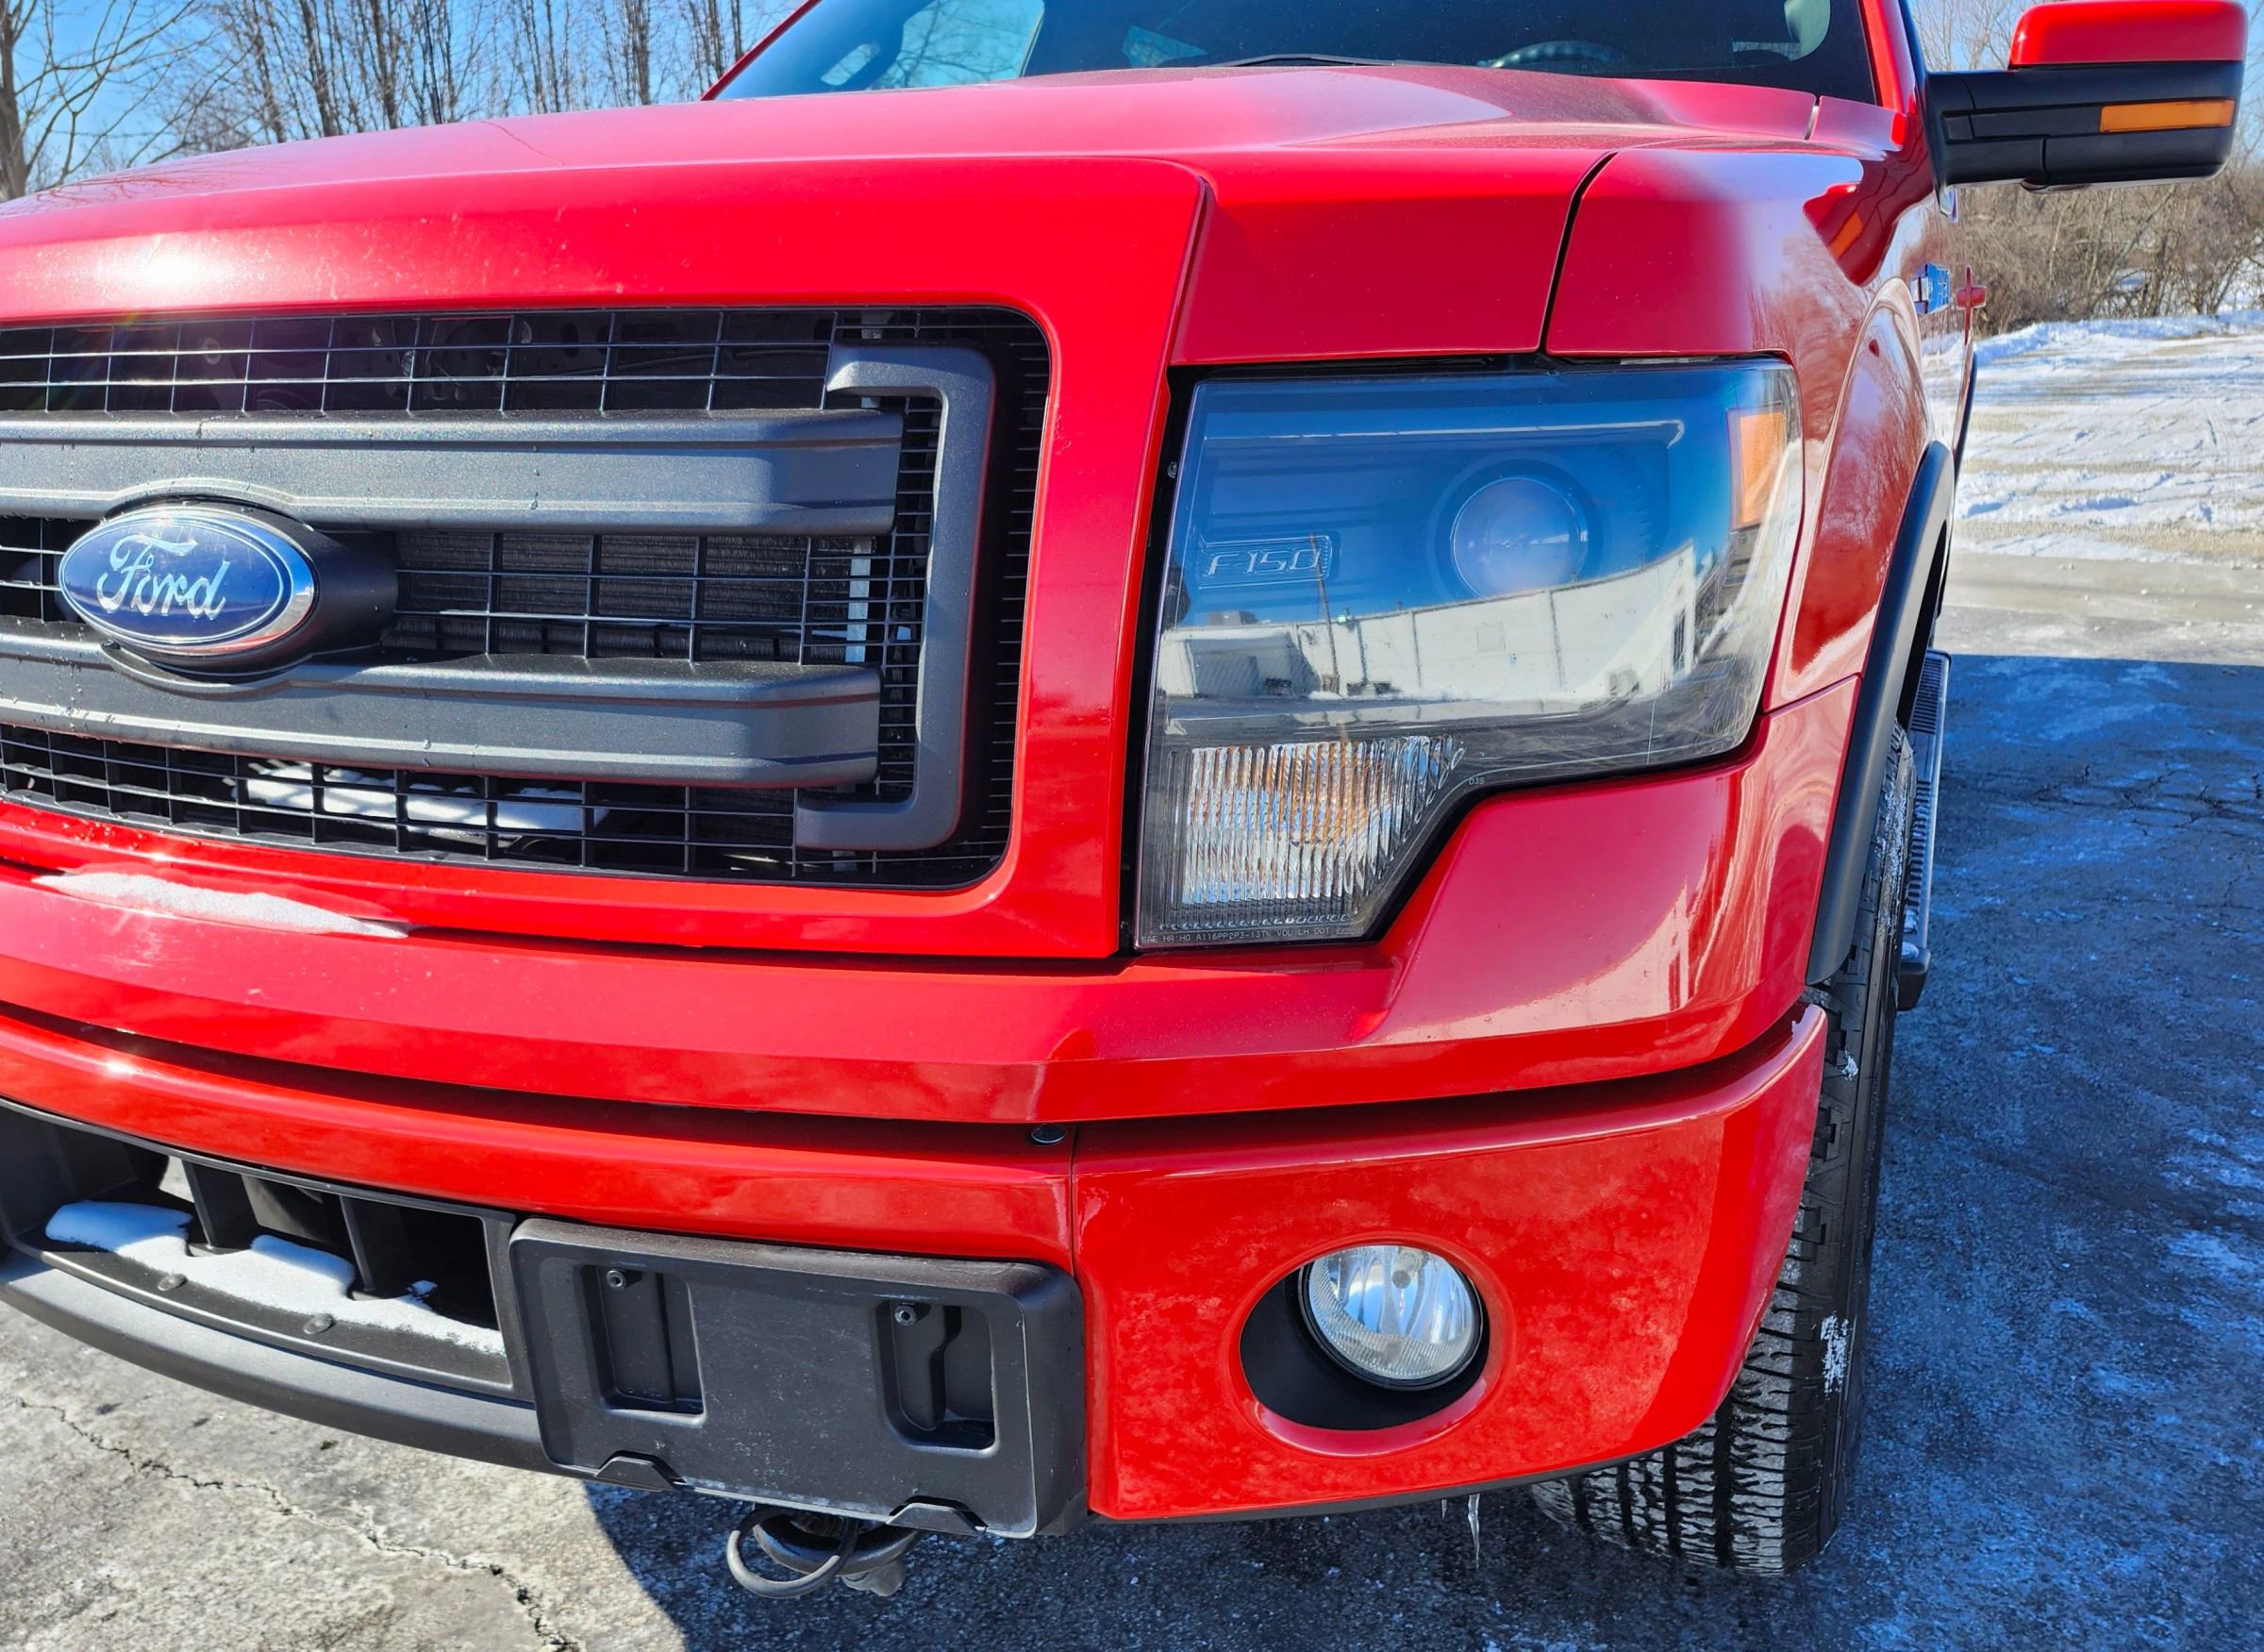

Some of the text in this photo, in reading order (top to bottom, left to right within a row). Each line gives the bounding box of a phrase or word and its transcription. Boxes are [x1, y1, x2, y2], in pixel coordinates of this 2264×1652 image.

[97, 534, 231, 620] Ford
[1468, 776, 1486, 785] D3S
[1140, 935, 1157, 943] SAE
